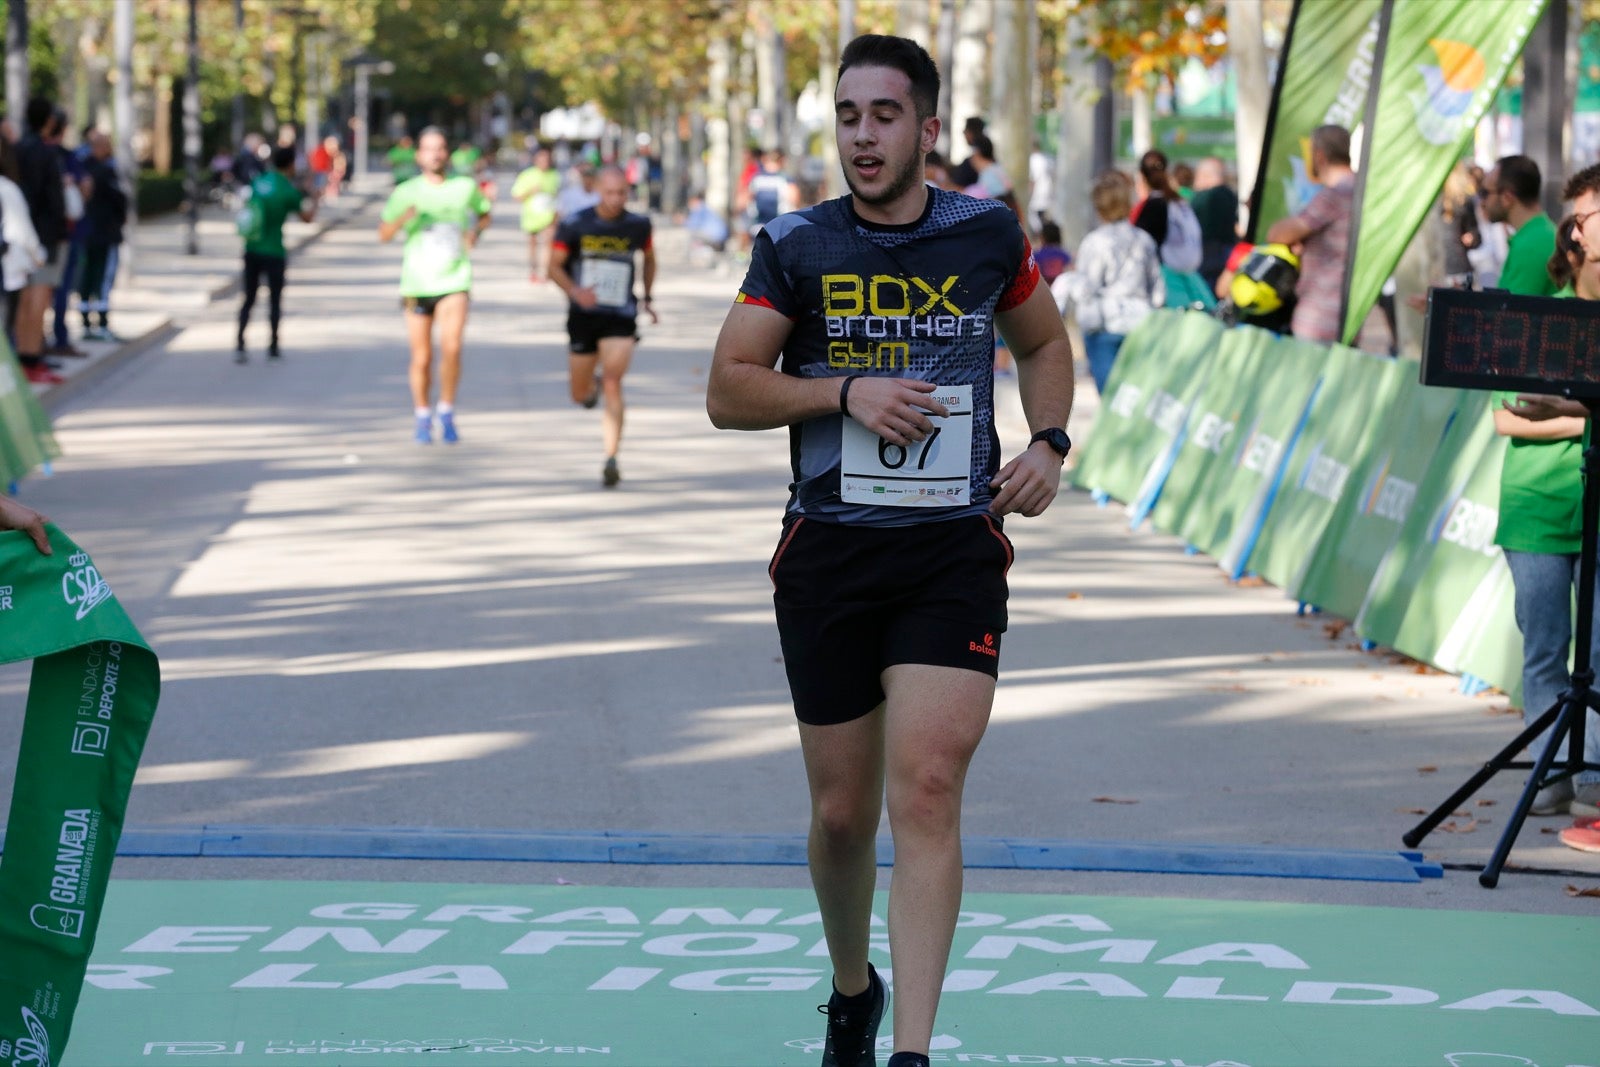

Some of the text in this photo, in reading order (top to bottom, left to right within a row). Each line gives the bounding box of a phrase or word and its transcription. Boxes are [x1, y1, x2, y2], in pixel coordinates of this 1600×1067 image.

[822, 274, 965, 317] BOX
[878, 427, 941, 470] 67
[62, 565, 99, 605] CSD
[97, 661, 119, 720] DEPORTE
[50, 808, 91, 903] GRANADA
[120, 926, 449, 953] EN
[229, 963, 510, 990] LA
[265, 1046, 611, 1054] DEPORTE JOVEN
